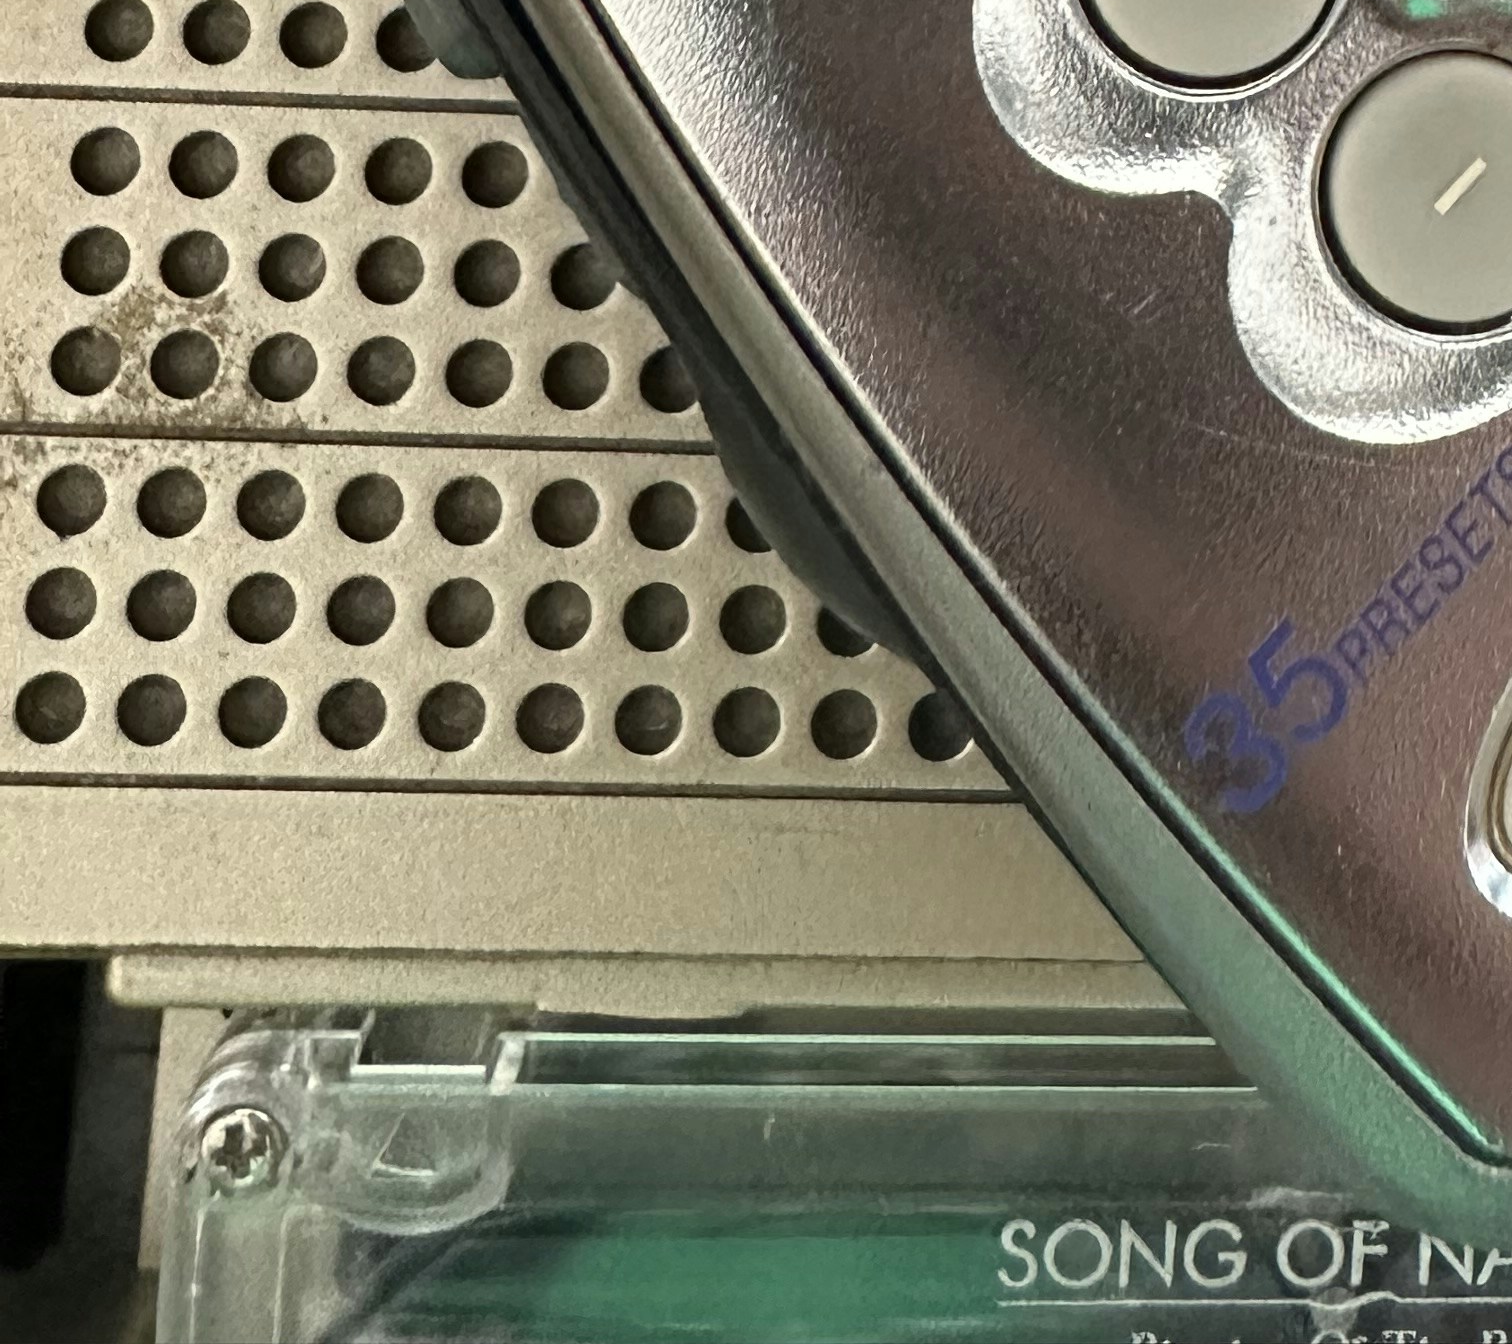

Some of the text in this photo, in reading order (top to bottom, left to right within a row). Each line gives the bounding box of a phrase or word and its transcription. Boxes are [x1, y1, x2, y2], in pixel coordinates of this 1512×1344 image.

[1184, 620, 1348, 814] 35
[997, 1219, 1247, 1288] SONG
[1276, 1219, 1390, 1288] OF
